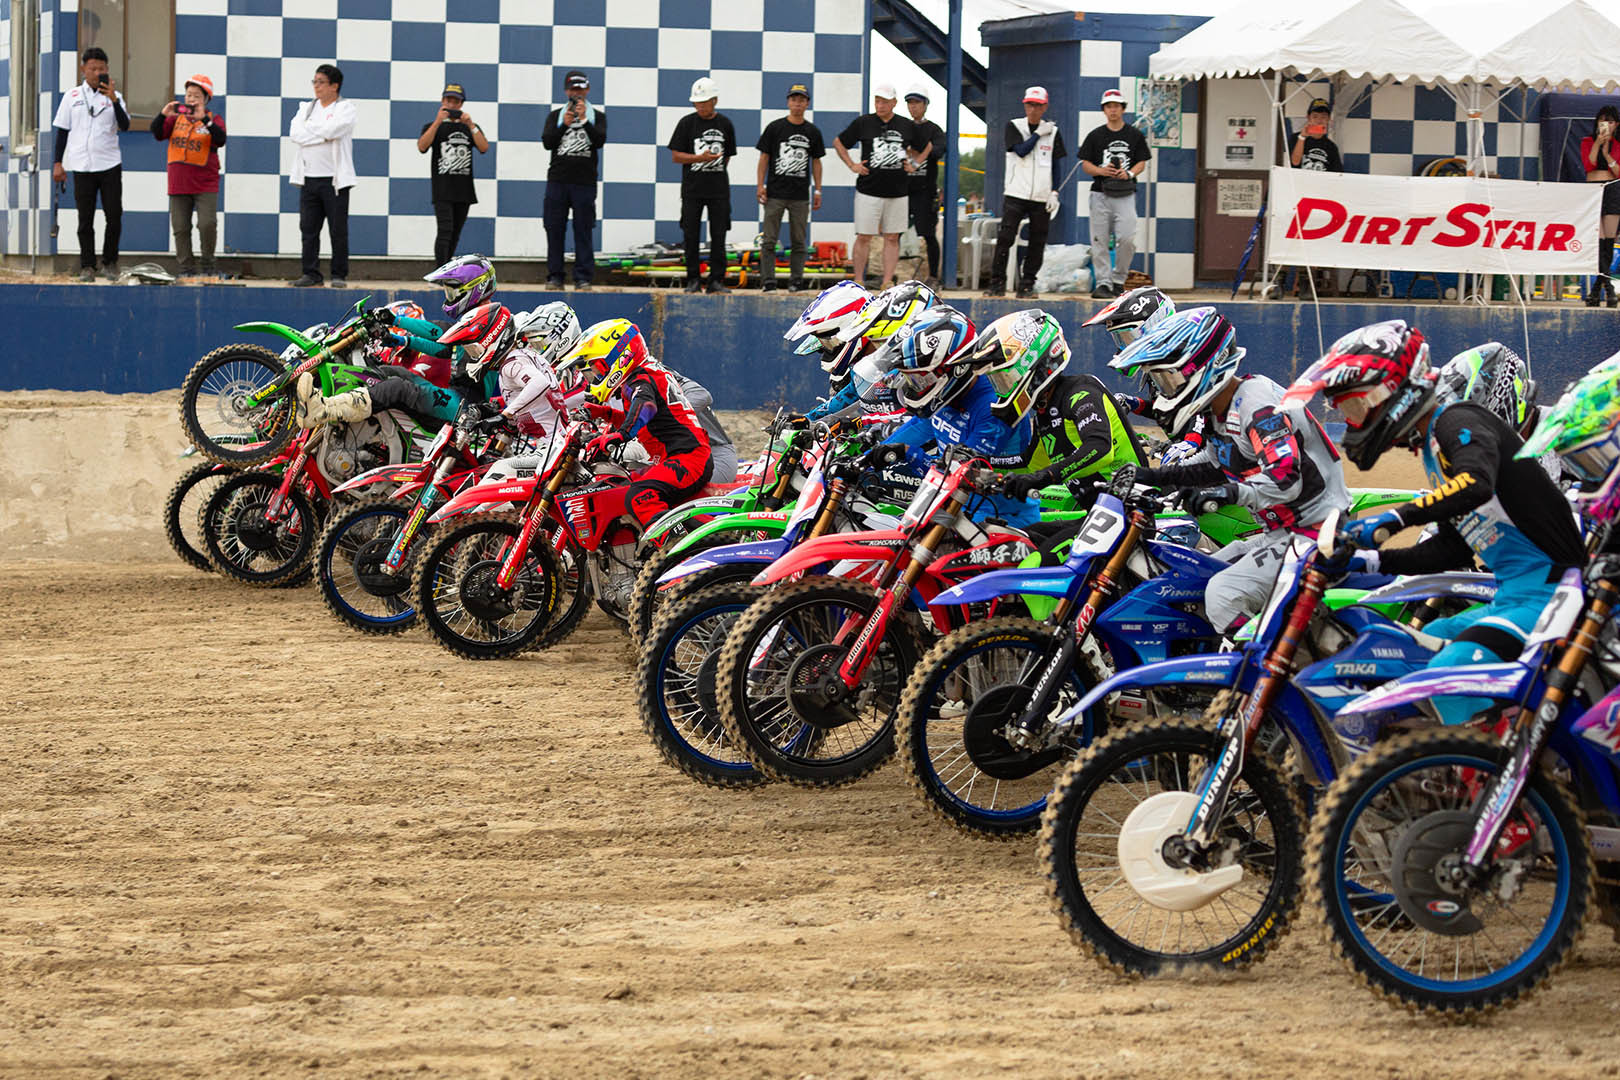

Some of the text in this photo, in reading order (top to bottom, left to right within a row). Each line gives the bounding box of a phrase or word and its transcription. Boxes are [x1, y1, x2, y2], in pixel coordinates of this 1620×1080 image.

[171, 136, 202, 152] PRESS
[1431, 202, 1577, 252] STAR
[1129, 295, 1151, 315] 34
[482, 313, 509, 349] 100Percent
[600, 329, 622, 342] LG
[1051, 343, 1062, 355] BELL
[1214, 349, 1229, 367] SHOEI
[608, 370, 622, 386] Arai
[1488, 359, 1518, 411] SCOTT
[254, 383, 278, 401] Vesrah
[931, 415, 962, 443] DFG
[882, 470, 924, 486] Kawa
[498, 486, 525, 494] MOTUL
[562, 485, 612, 499] Honda Dream
[1414, 472, 1477, 508] THOR
[750, 511, 786, 520] MOTUL
[500, 529, 526, 579] DUNLOP
[969, 541, 1030, 565] 獅子丸
[848, 606, 884, 663] BRIDGESTONE
[978, 634, 1031, 648] DUNLOP
[1370, 648, 1406, 659] YAMAHA
[1032, 647, 1063, 702] DUNLOP
[1333, 663, 1377, 676] TAKA
[1198, 736, 1239, 822] DUNLOP
[1474, 756, 1517, 834] DUNLOP
[1222, 915, 1275, 963] DUNLOP
